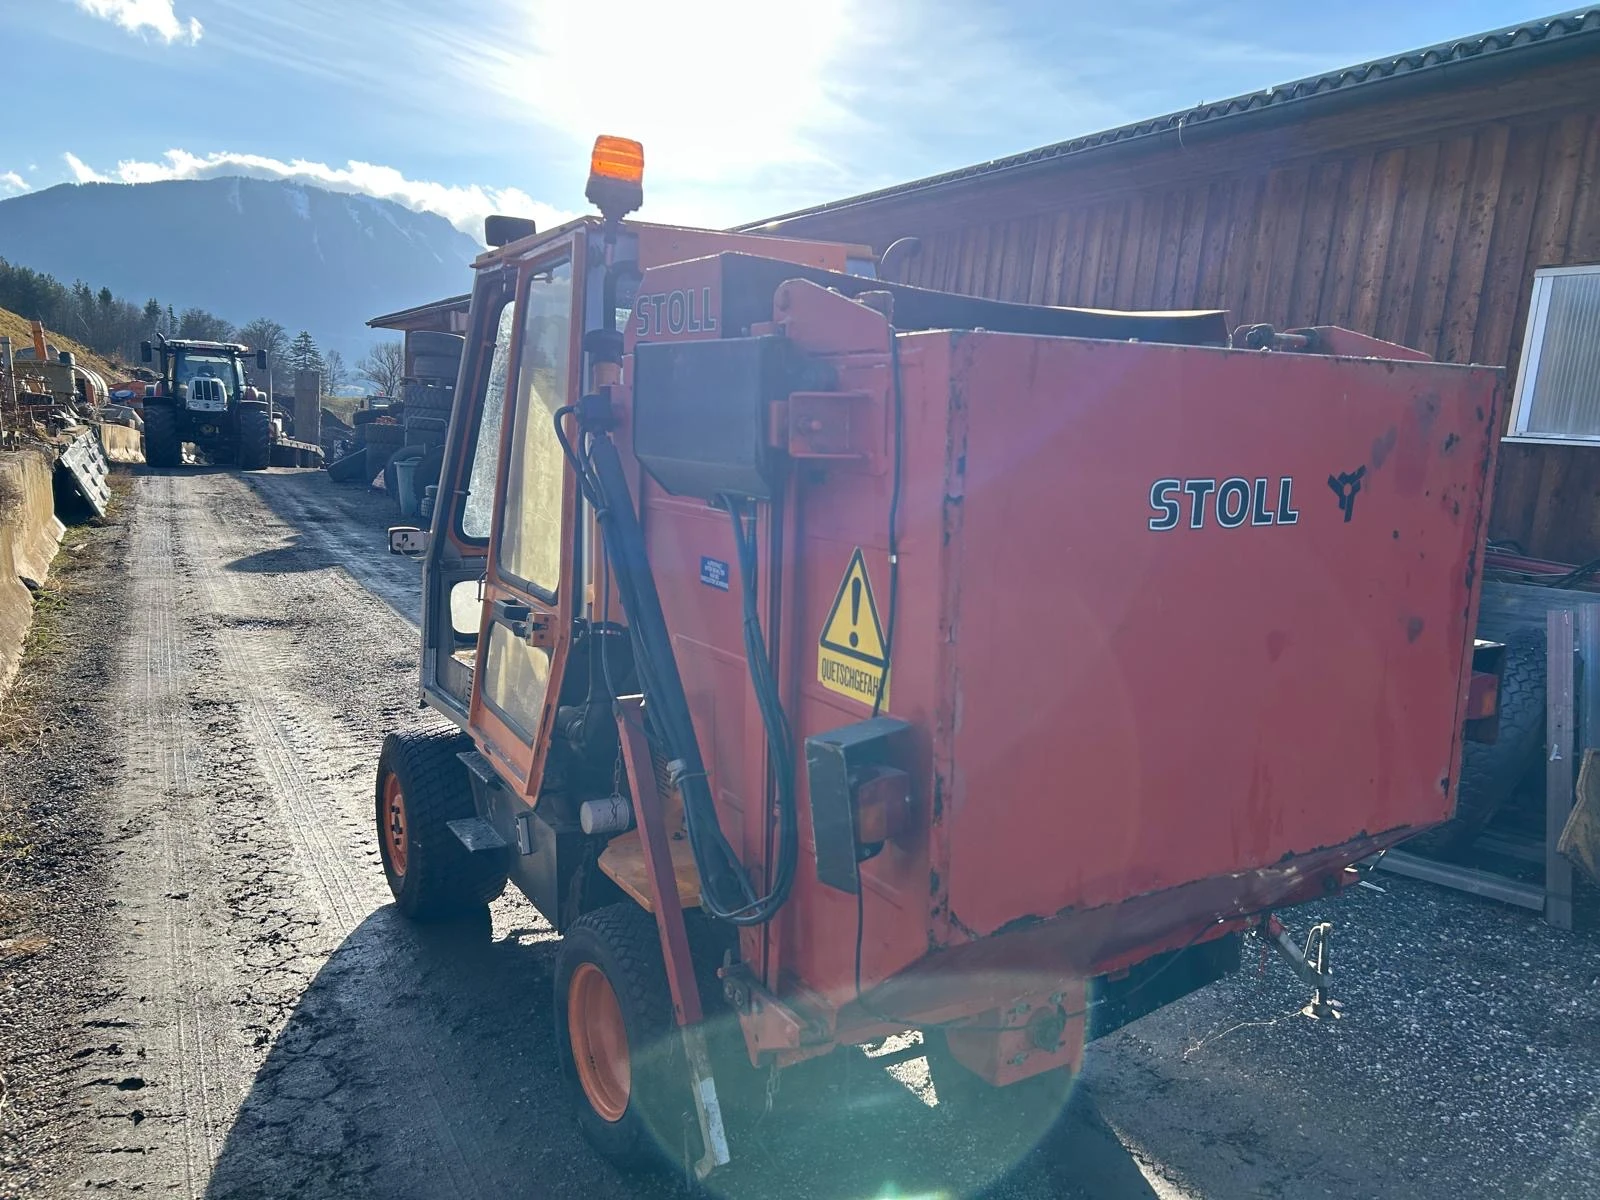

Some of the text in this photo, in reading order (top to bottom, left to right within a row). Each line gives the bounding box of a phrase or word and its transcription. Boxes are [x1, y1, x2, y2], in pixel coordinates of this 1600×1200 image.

[636, 287, 717, 336] STOLL
[1149, 477, 1299, 531] STOLL
[821, 657, 880, 697] QUETSCHGEFAH
